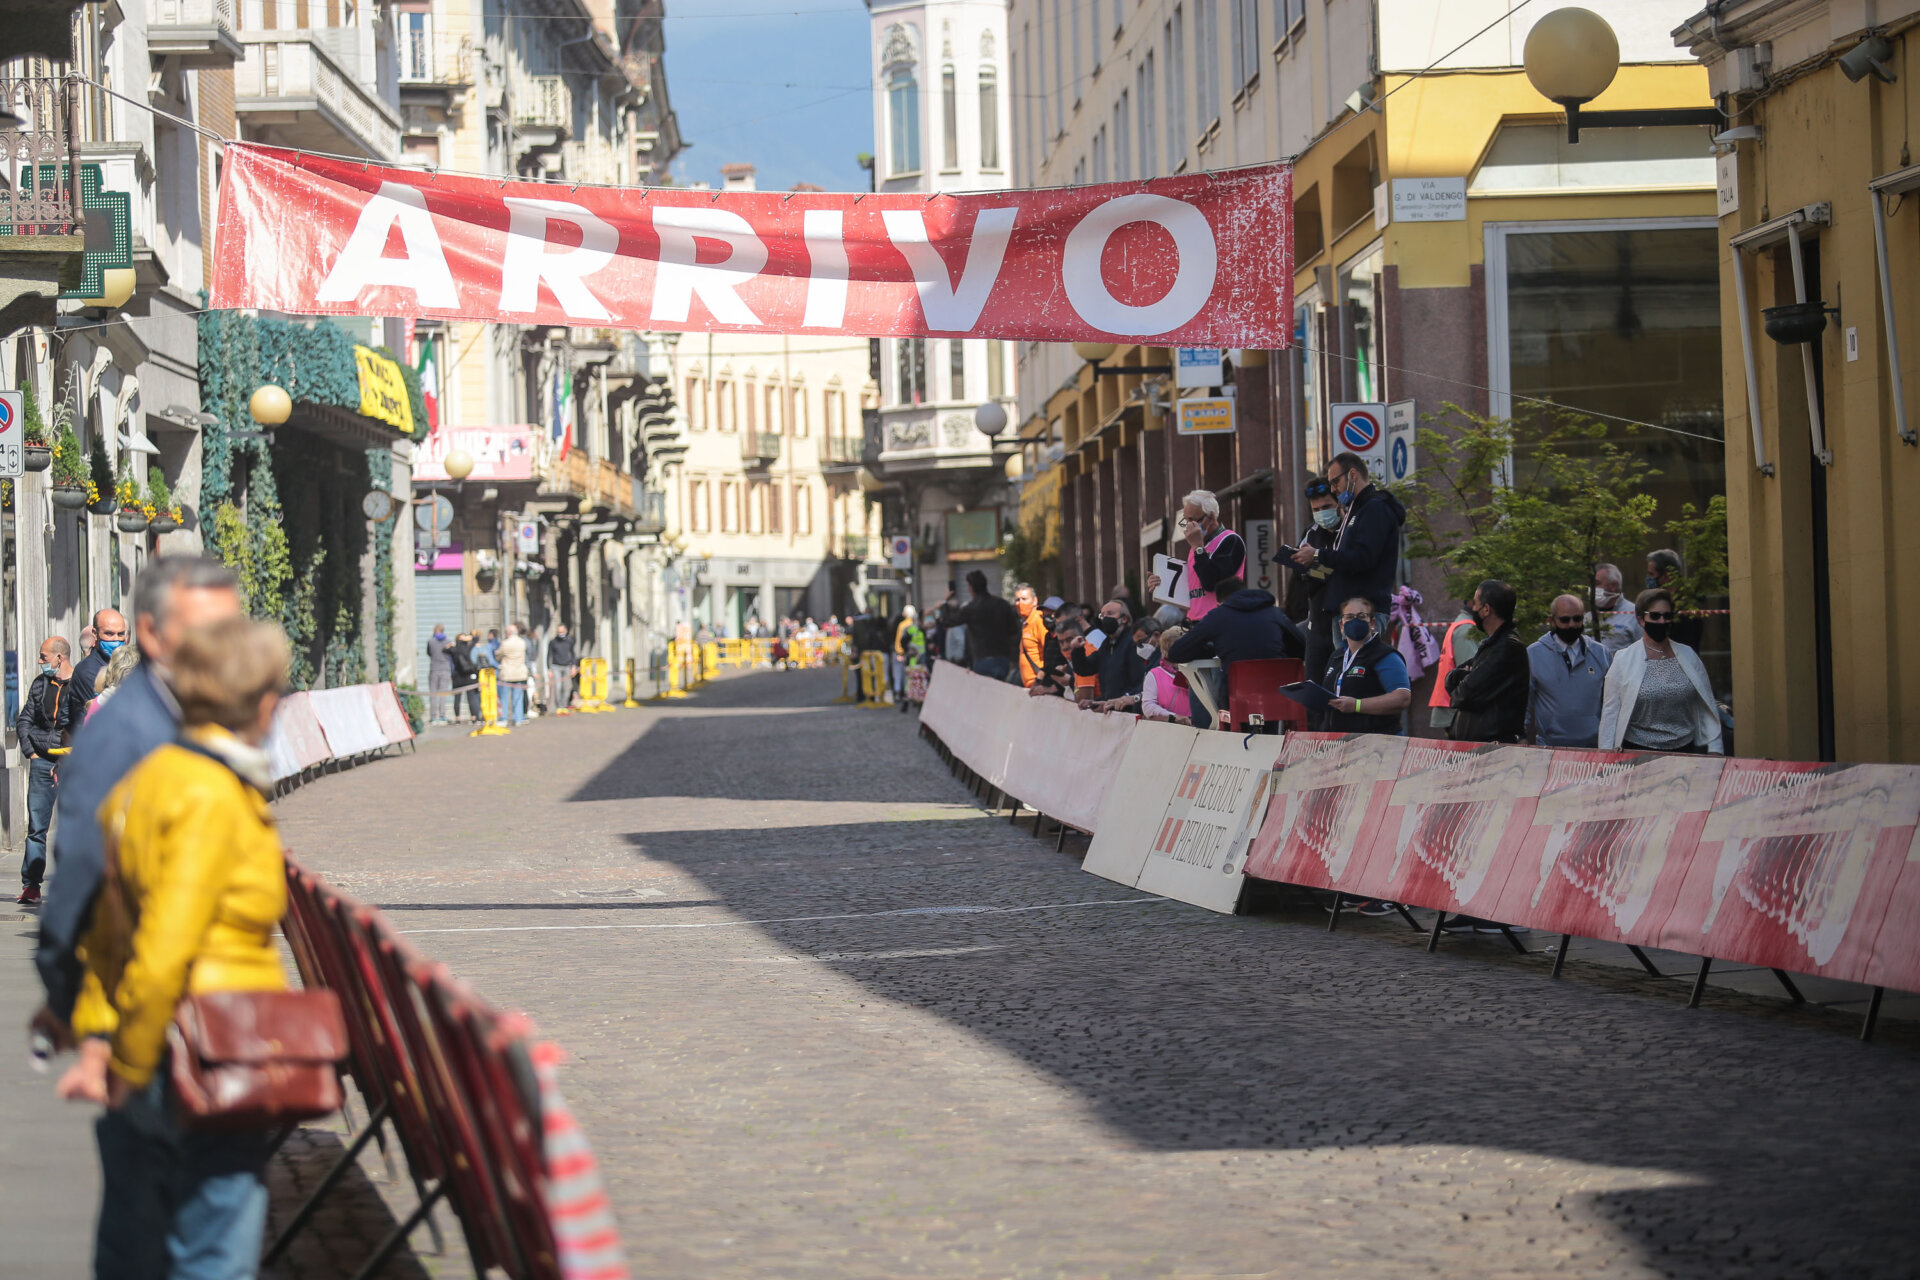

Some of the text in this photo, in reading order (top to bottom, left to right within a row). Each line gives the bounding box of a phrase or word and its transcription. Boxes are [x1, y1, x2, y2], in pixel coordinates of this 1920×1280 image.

[1407, 193, 1415, 201] DI
[1420, 192, 1463, 201] VALDENGO
[1720, 186, 1734, 205] ITALIA
[315, 181, 1219, 336] ARRIVO
[1166, 561, 1184, 598] 7
[1193, 763, 1251, 814] REGIONE
[1171, 820, 1228, 870] PIEMONTE
